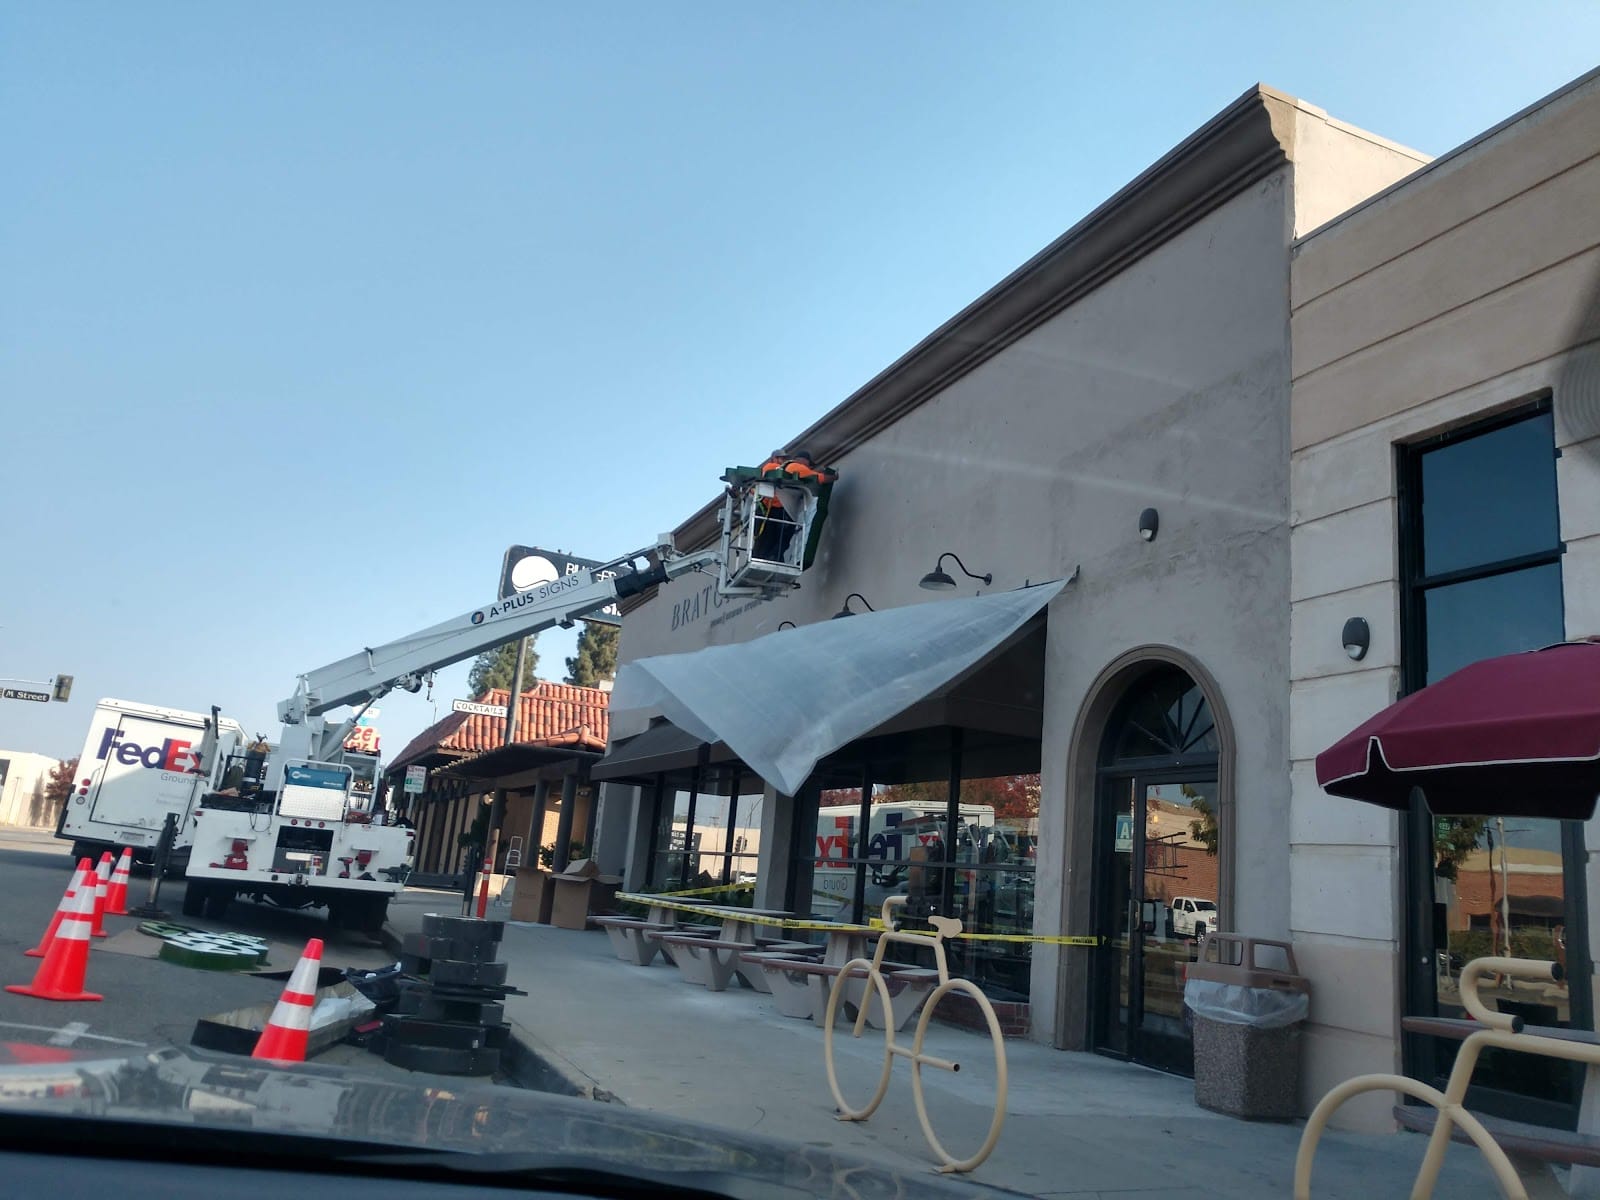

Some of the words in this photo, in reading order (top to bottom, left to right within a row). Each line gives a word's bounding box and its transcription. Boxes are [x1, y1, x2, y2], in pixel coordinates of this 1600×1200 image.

[490, 593, 534, 618] A-PLUS
[539, 576, 579, 598] SIGNS
[16, 691, 48, 701] Street
[456, 702, 504, 715] COCKTAILS
[1120, 822, 1129, 839] A
